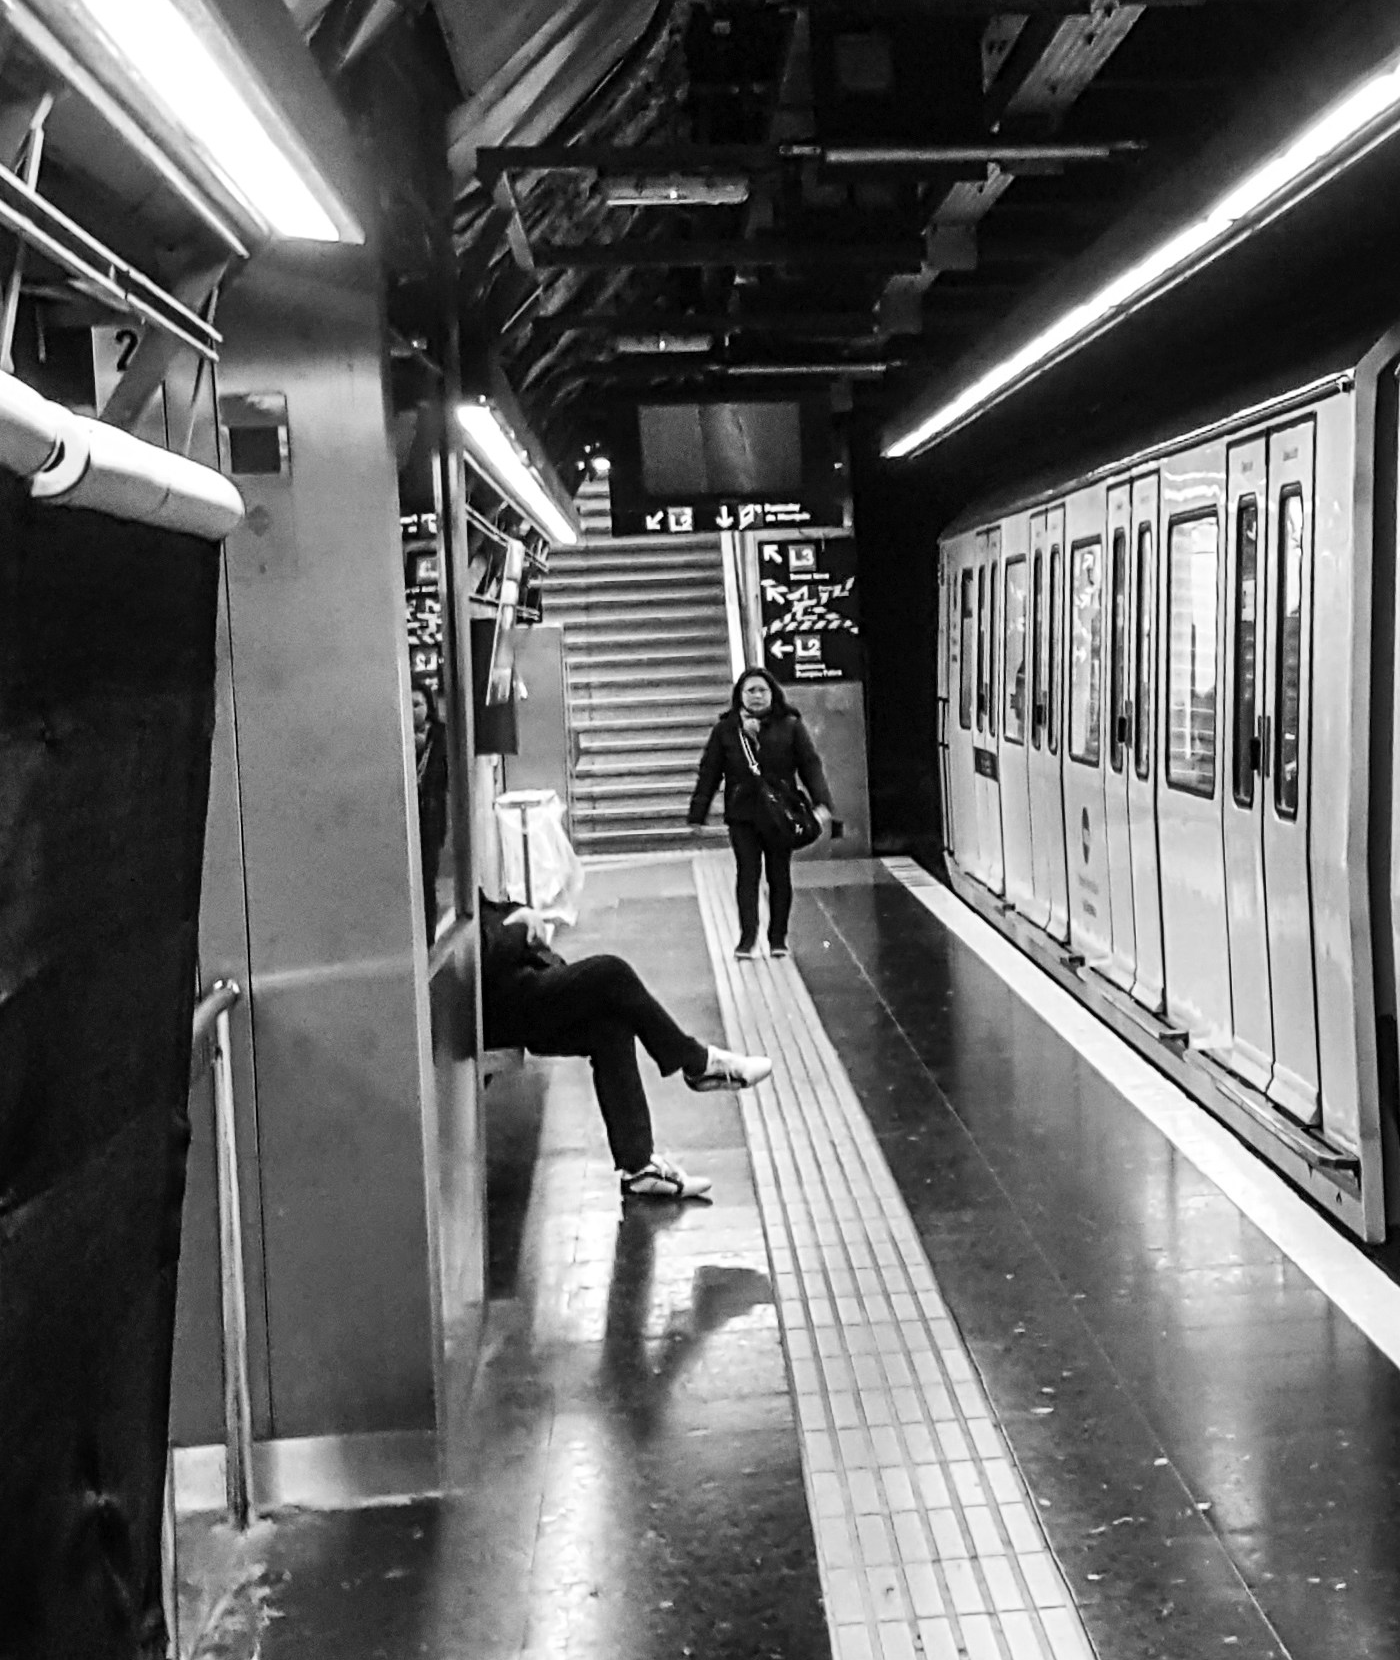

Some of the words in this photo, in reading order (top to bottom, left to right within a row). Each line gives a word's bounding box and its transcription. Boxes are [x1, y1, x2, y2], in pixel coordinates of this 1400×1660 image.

[669, 514, 692, 532] L2
[789, 549, 815, 566] L3
[795, 638, 821, 656] L2
